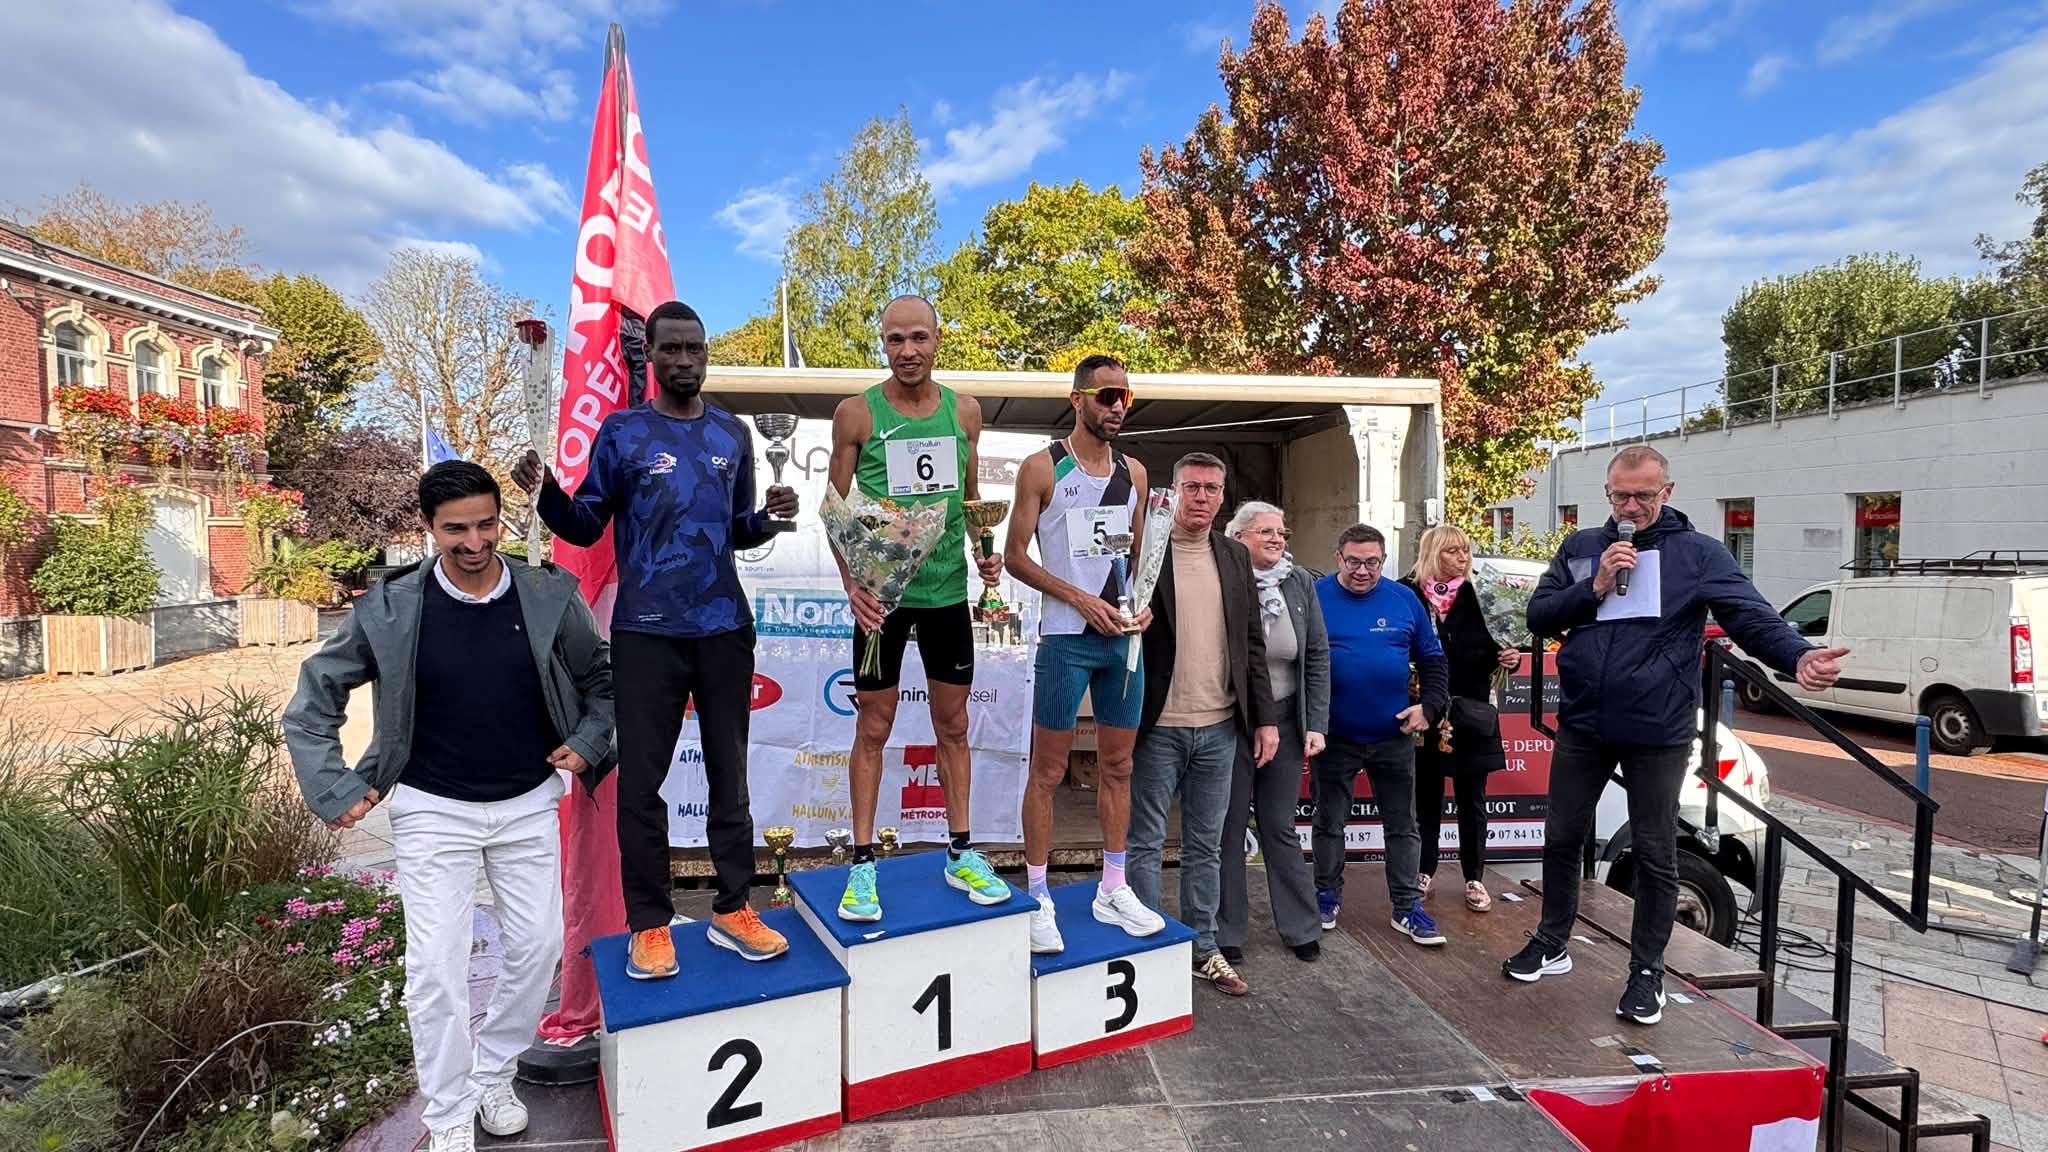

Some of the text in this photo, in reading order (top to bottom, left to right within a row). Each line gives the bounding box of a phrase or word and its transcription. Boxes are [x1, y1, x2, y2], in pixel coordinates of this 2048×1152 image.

[916, 453, 934, 481] 6
[1093, 521, 1108, 546] 5
[1514, 740, 1553, 753] DEPU
[1505, 758, 1528, 772] UR
[900, 809, 948, 820] MÉTROPO
[1350, 803, 1380, 816] CHA
[1498, 829, 1511, 840] 07
[1514, 829, 1527, 840] 84
[1363, 854, 1384, 862] CON
[1105, 959, 1138, 1034] 3
[912, 973, 952, 1051] 1
[706, 1038, 762, 1129] 2
